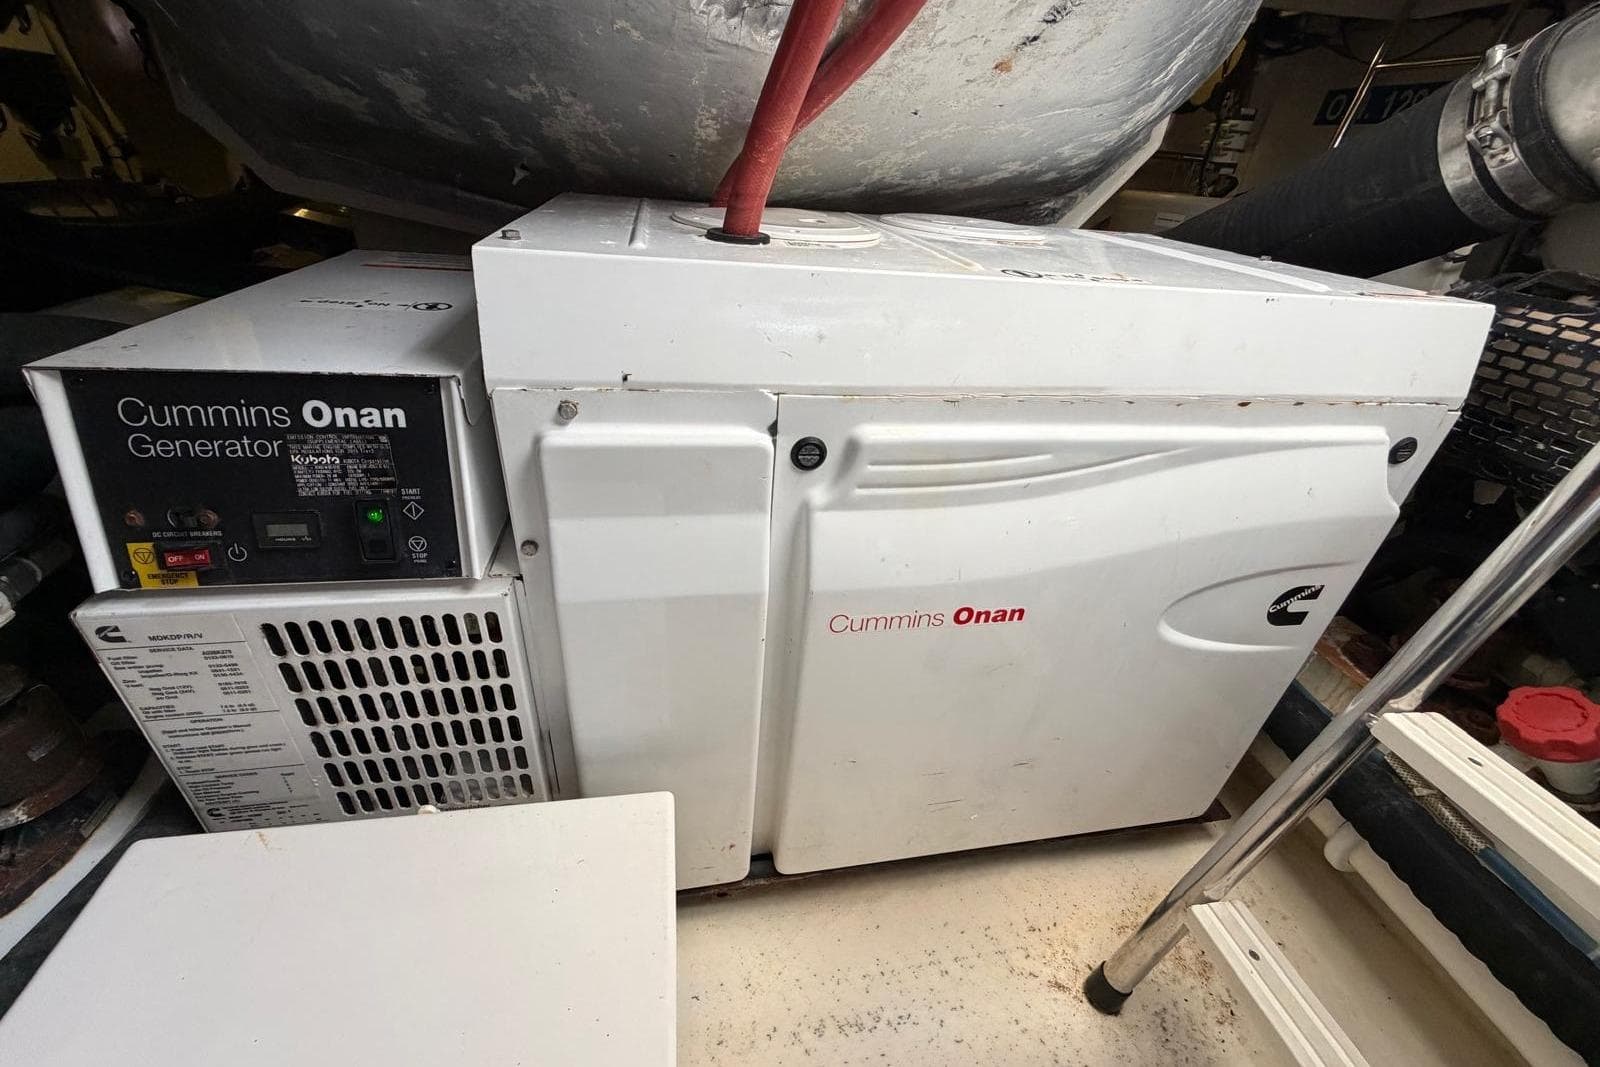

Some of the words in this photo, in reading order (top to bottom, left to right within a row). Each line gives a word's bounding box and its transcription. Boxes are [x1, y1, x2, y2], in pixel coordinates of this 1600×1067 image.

[117, 397, 291, 428] Cummins
[301, 399, 407, 429] Onan
[127, 433, 283, 458] Generator
[290, 454, 340, 465] Kubota
[194, 553, 206, 561] ON
[829, 609, 945, 634] Cummins
[952, 606, 1026, 626] Onan
[148, 632, 203, 642] MDKDP/R/V
